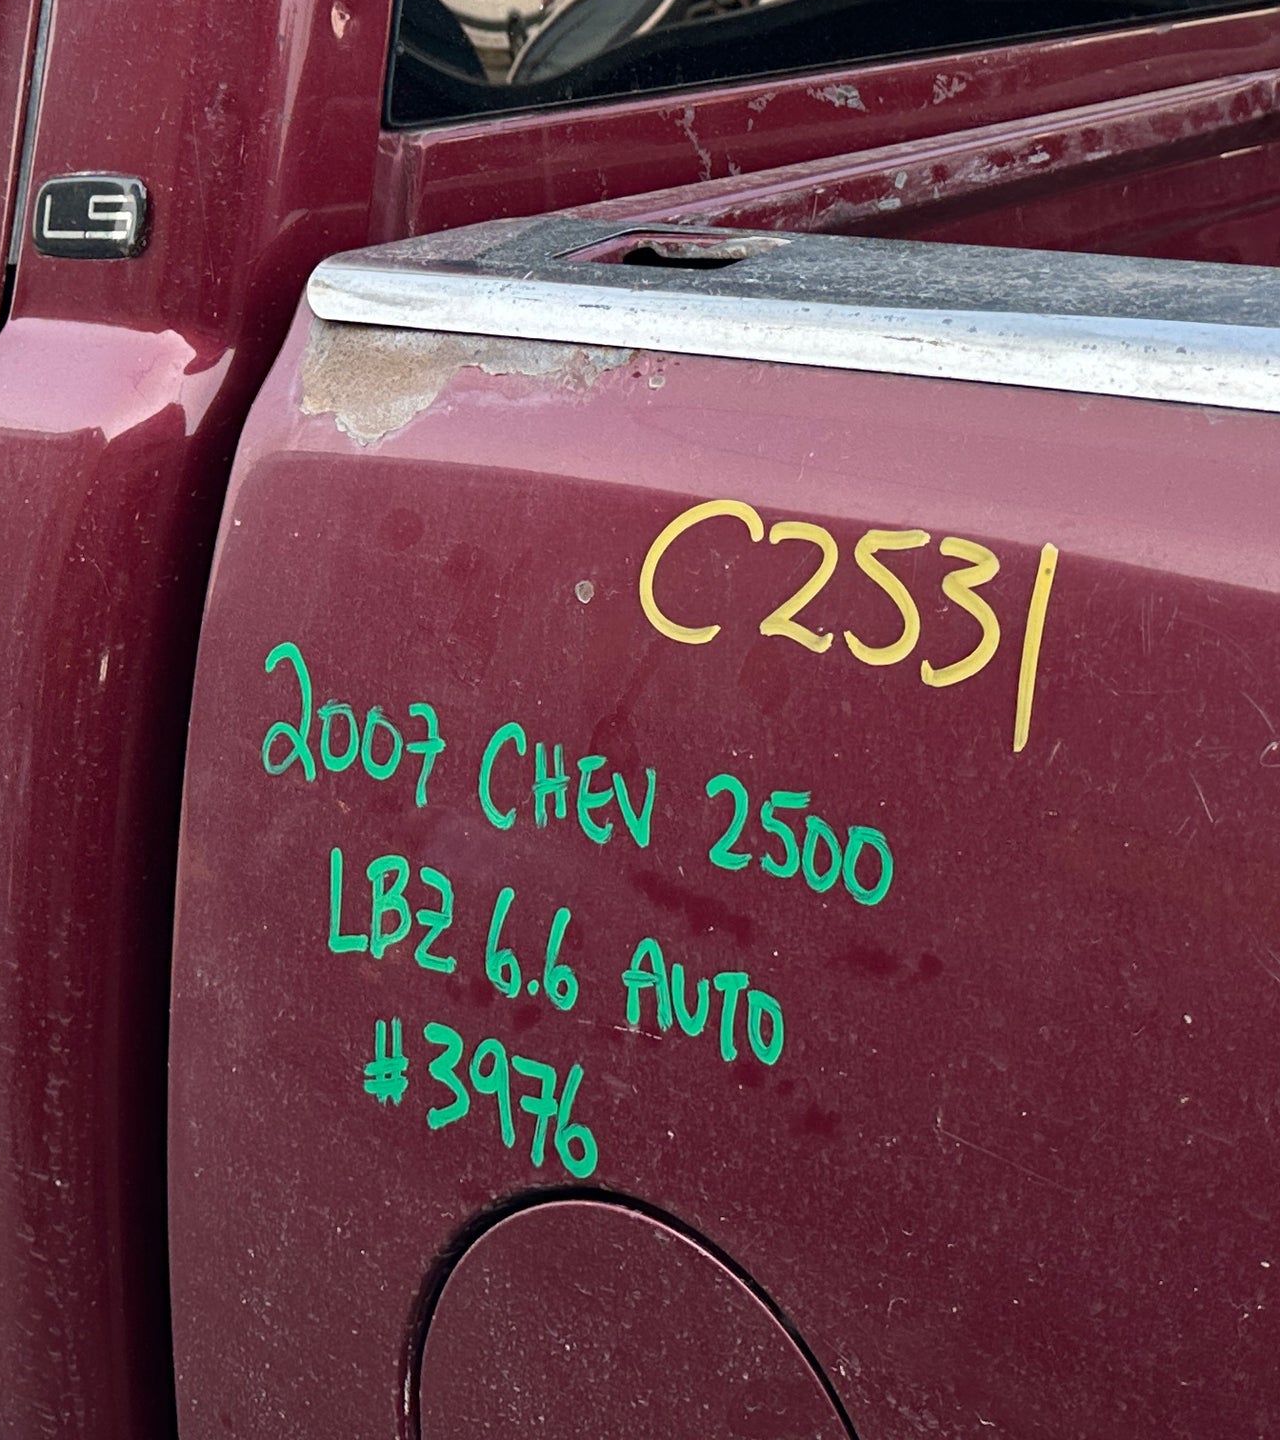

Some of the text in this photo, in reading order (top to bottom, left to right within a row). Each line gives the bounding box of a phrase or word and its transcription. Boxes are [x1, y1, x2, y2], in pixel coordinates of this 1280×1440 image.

[42, 194, 134, 240] LS
[639, 499, 1059, 753] C2531
[262, 643, 894, 905] 2007 CHEV 2500
[327, 848, 785, 1065] LBZ 6.6 AUTO
[363, 1017, 599, 1178] #3976
